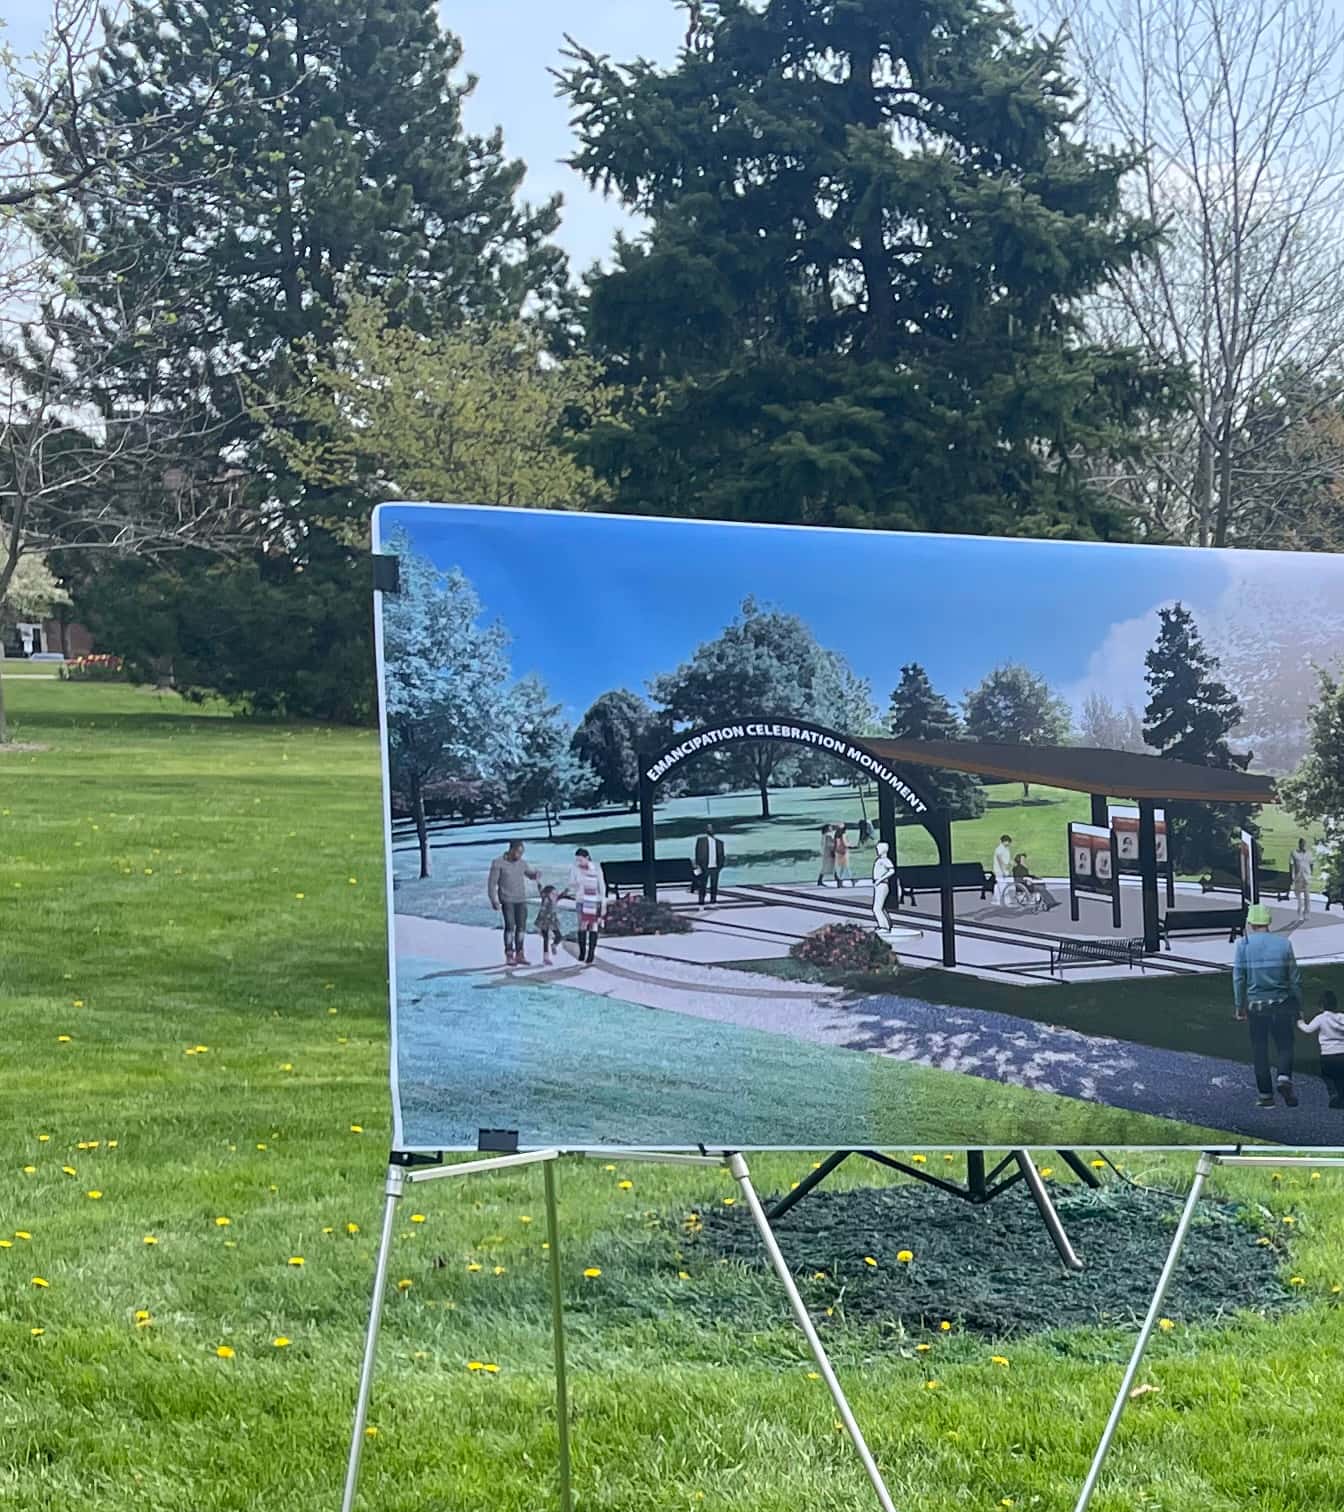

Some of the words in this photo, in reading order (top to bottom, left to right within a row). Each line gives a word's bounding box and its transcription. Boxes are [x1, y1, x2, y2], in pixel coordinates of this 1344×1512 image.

[646, 724, 744, 783] EMANCIPATION
[746, 723, 845, 754] CELEBRATION
[846, 746, 928, 814] MONUMENT
